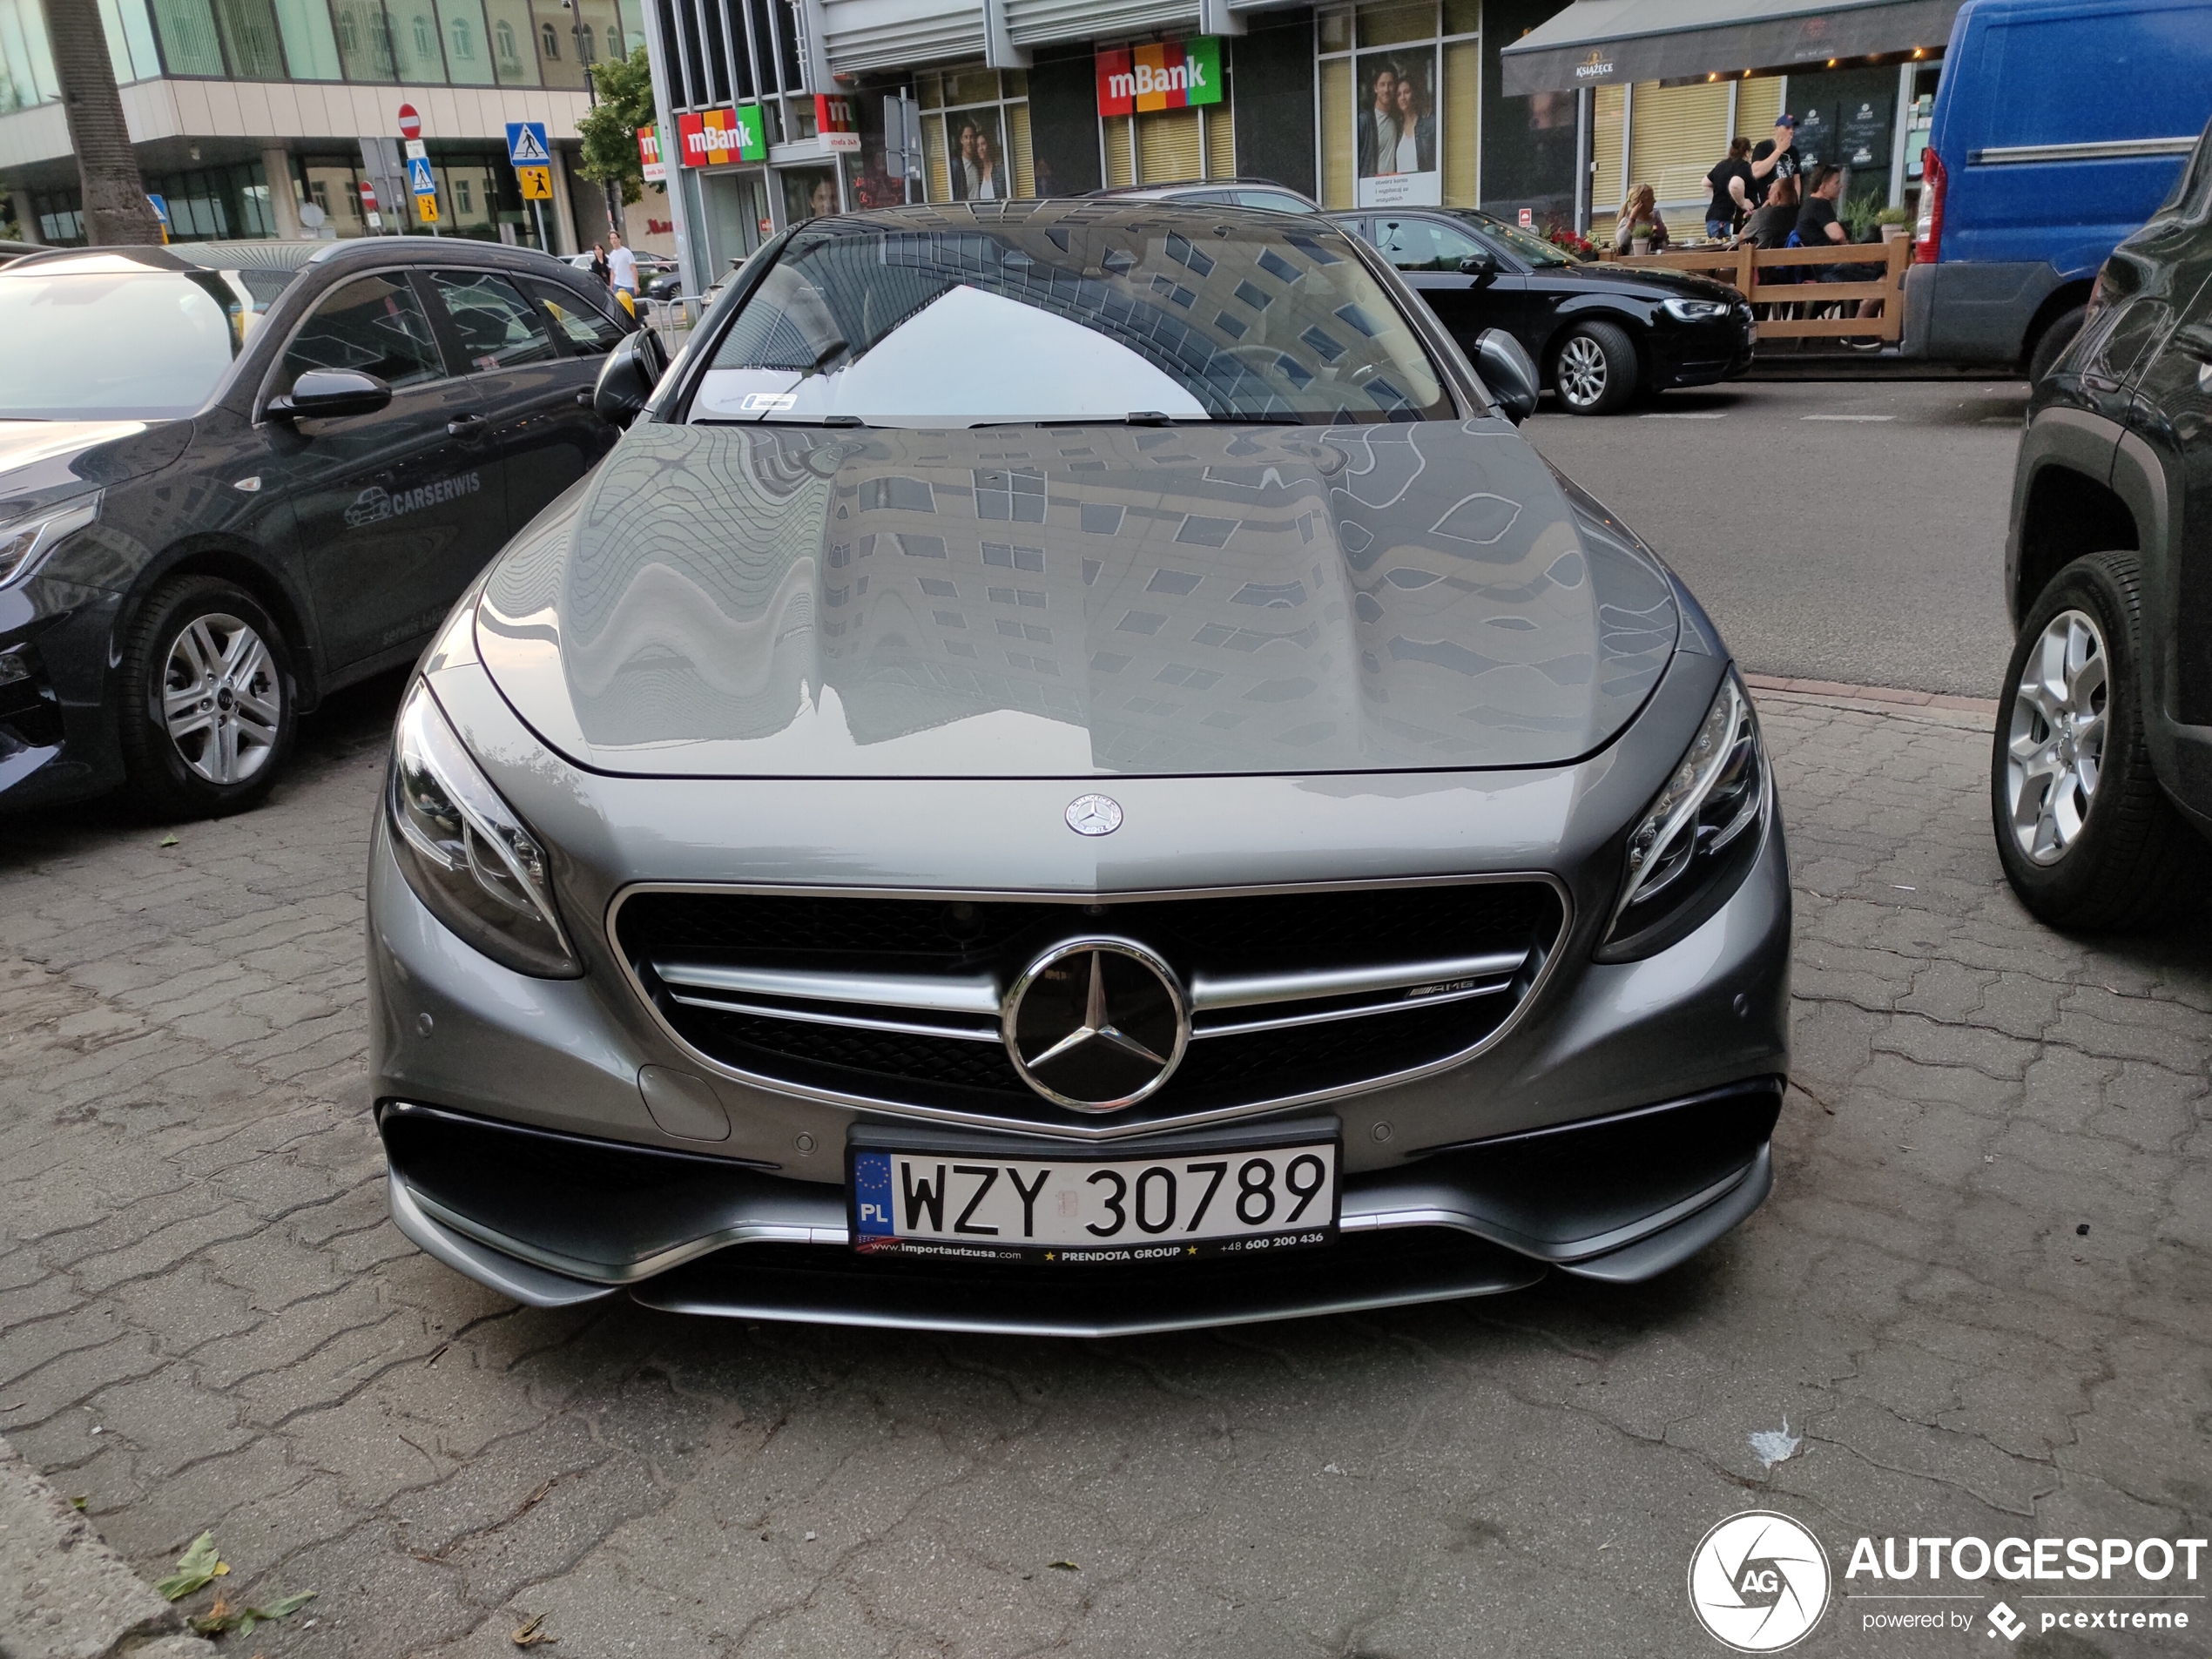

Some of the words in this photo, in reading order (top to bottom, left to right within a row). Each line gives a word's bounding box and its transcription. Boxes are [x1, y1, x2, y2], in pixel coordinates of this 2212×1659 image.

[1109, 55, 1206, 98] mBank
[828, 101, 853, 122] m
[641, 135, 660, 155] m
[687, 121, 753, 153] mBank
[393, 471, 480, 516] CARSERWIS
[1429, 981, 1474, 994] AMG
[860, 1204, 888, 1223] PL
[900, 1159, 1052, 1238] WZY
[1083, 1153, 1326, 1238] 30789
[872, 1243, 1022, 1260] www.importautzusa.com
[1220, 1241, 1242, 1252] +48
[1245, 1238, 1270, 1250] 600
[1273, 1236, 1297, 1247] 200
[1299, 1232, 1324, 1244] 436
[1062, 1251, 1130, 1262] PRENDOTA
[1134, 1246, 1181, 1259] GROUP
